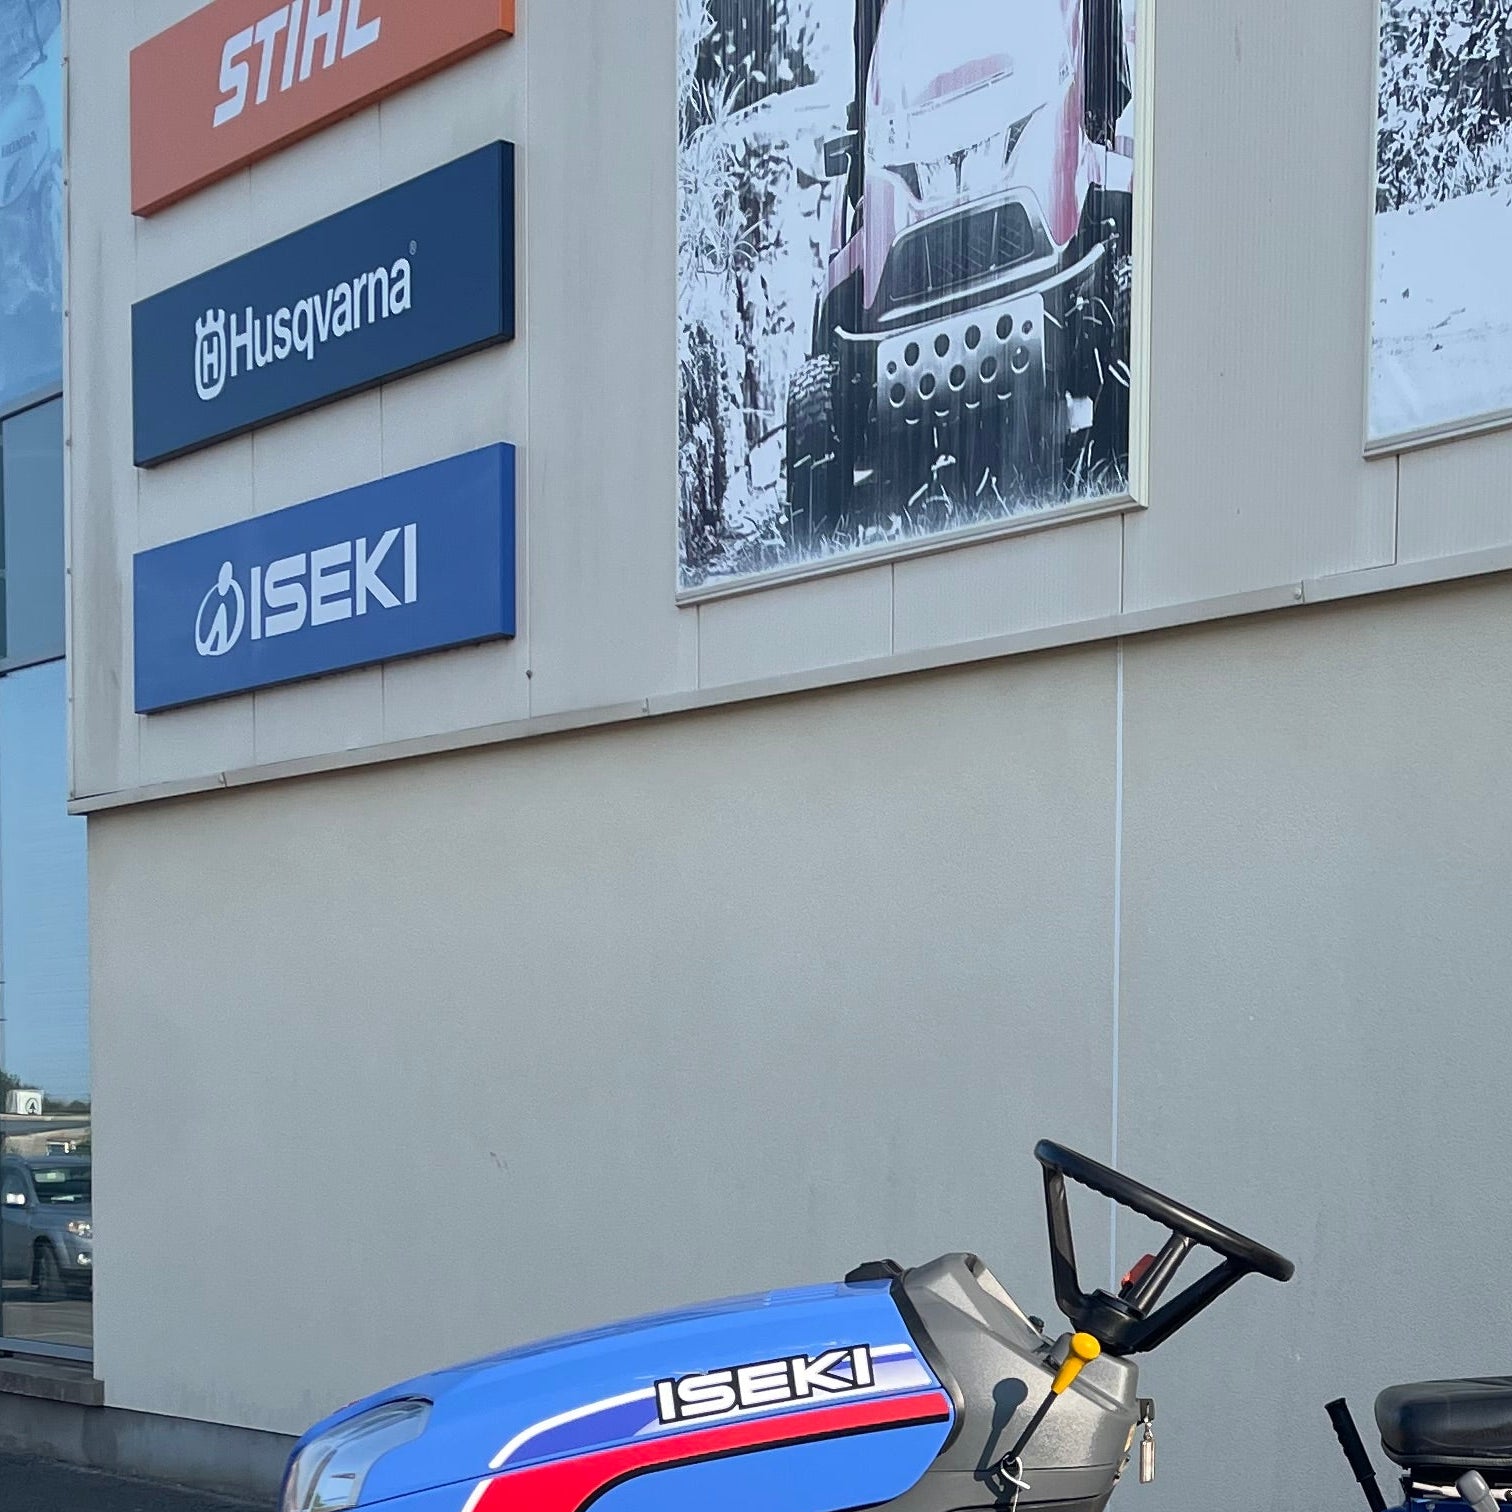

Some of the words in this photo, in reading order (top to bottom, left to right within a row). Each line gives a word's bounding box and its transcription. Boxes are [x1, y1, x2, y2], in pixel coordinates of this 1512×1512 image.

[213, 0, 382, 128] STIHL
[230, 257, 412, 377] Husqvarna
[250, 522, 418, 641] ISEKI
[654, 1343, 875, 1425] ISEKI
